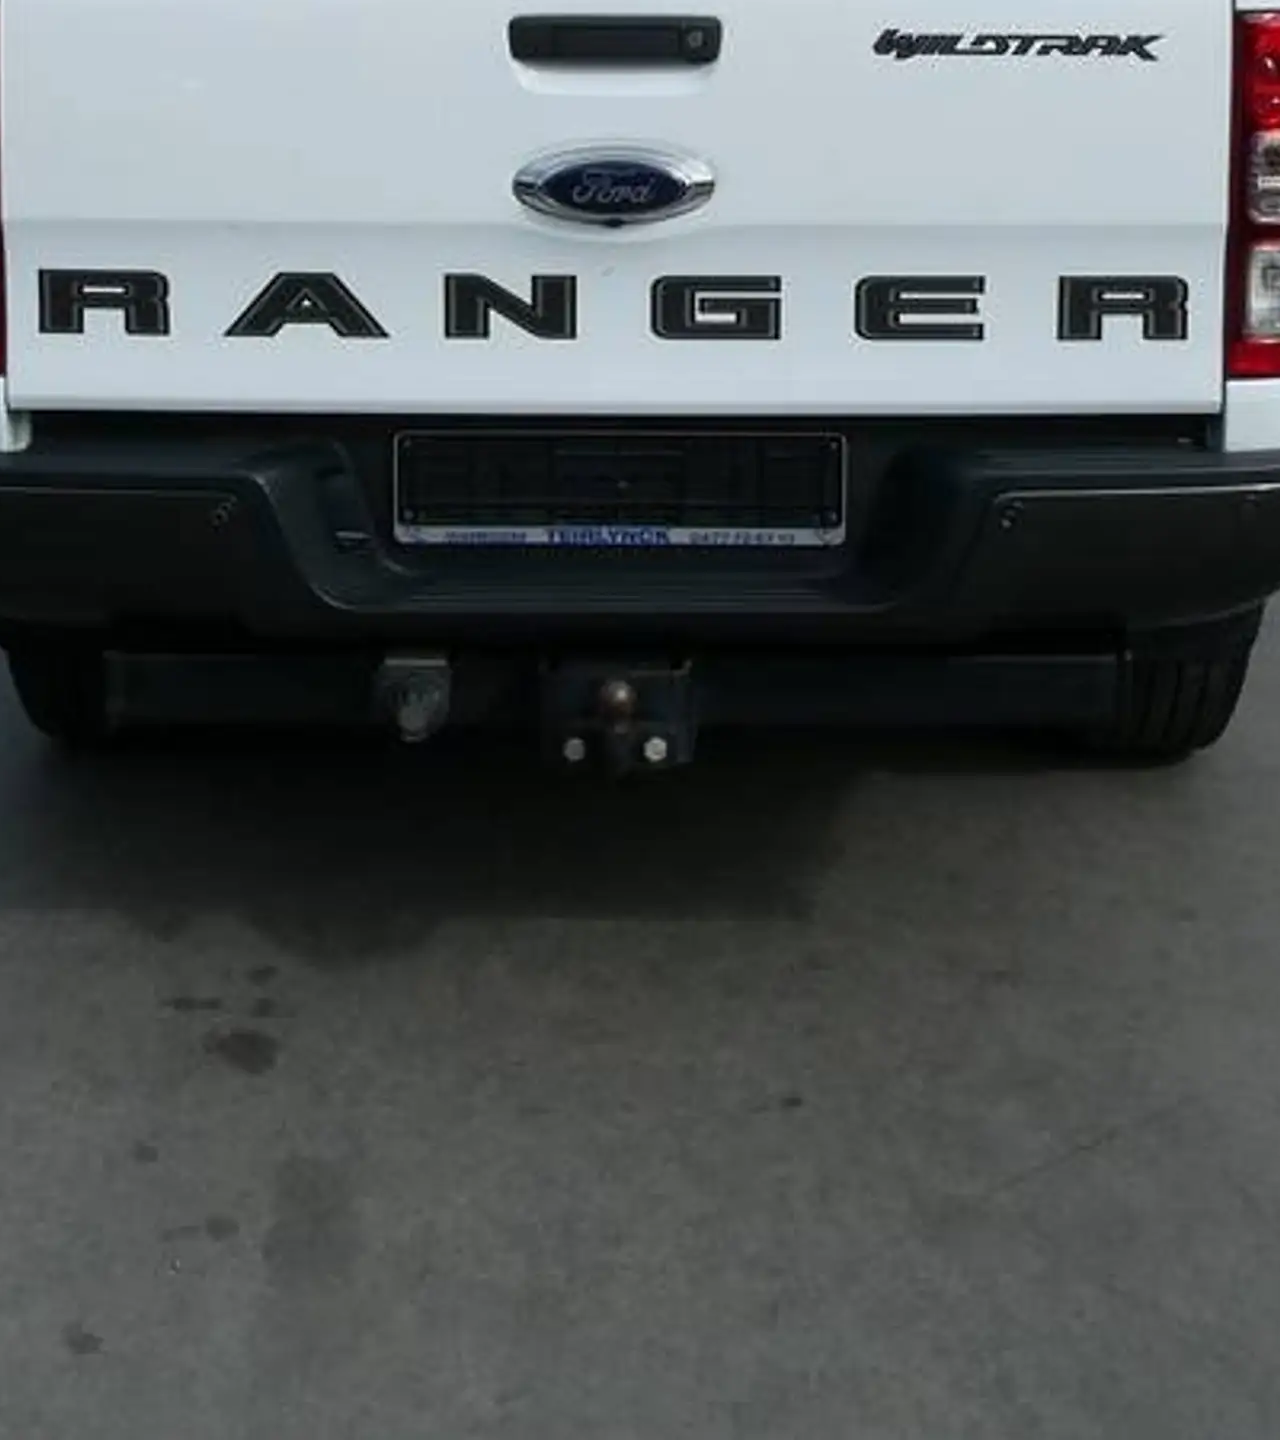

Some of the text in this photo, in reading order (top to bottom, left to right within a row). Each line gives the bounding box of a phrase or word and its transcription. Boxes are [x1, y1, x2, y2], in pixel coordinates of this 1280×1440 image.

[872, 29, 1163, 62] WILDTRAK
[572, 167, 657, 204] Ford
[36, 267, 1190, 342] RANGER
